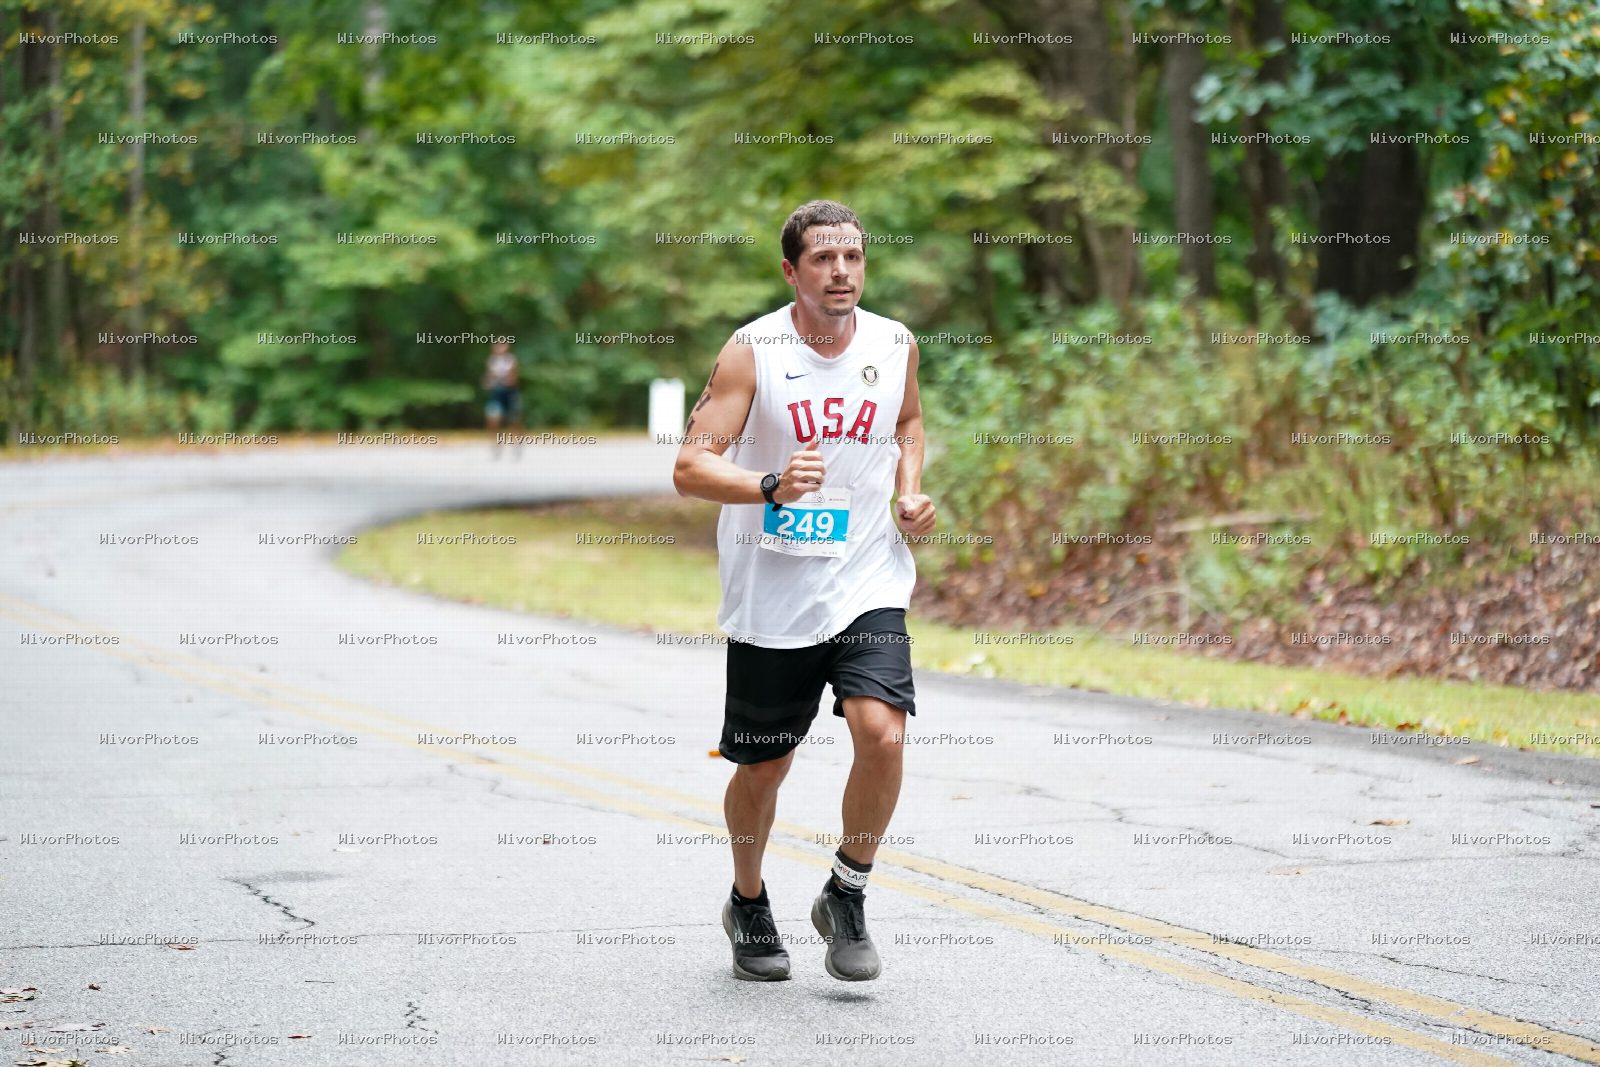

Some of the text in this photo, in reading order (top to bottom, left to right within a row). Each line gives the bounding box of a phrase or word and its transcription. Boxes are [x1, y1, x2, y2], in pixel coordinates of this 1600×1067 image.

[787, 398, 878, 444] USA
[776, 510, 835, 538] 249
[837, 864, 869, 881] MYLAPS
